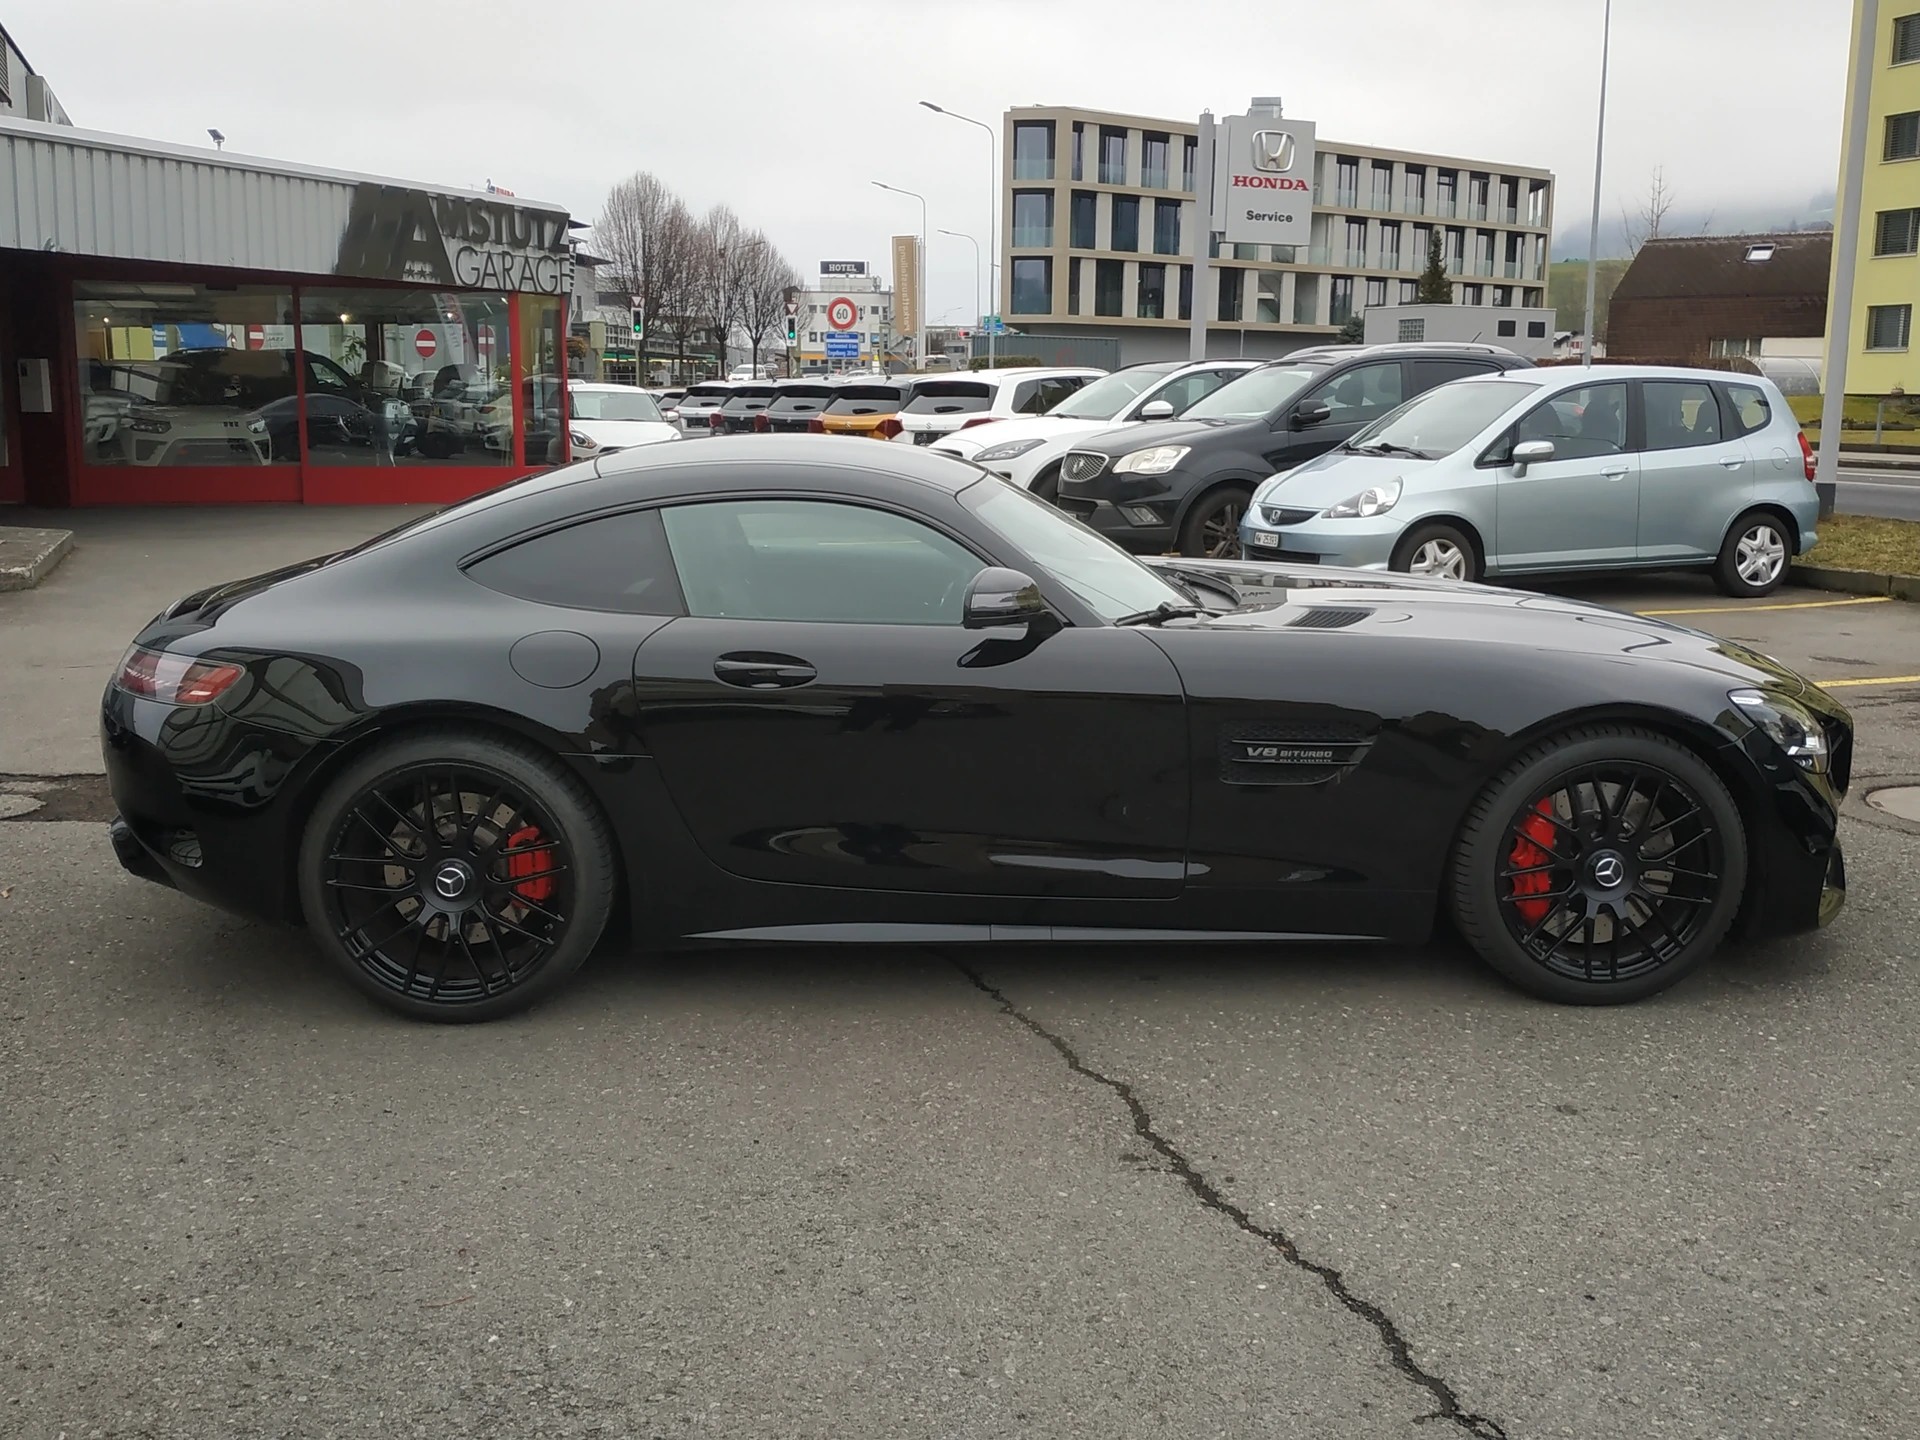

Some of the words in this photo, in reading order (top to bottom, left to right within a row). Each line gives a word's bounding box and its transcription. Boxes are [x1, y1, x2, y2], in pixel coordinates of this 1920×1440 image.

[1232, 175, 1310, 192] HONDA
[1246, 209, 1294, 223] Service
[344, 183, 570, 285] AMSTUTZ
[455, 245, 573, 294] GARAGE
[828, 263, 858, 272] HOTEL
[836, 308, 849, 320] 60
[1246, 747, 1277, 757] V8
[1279, 750, 1333, 758] BITURBO
